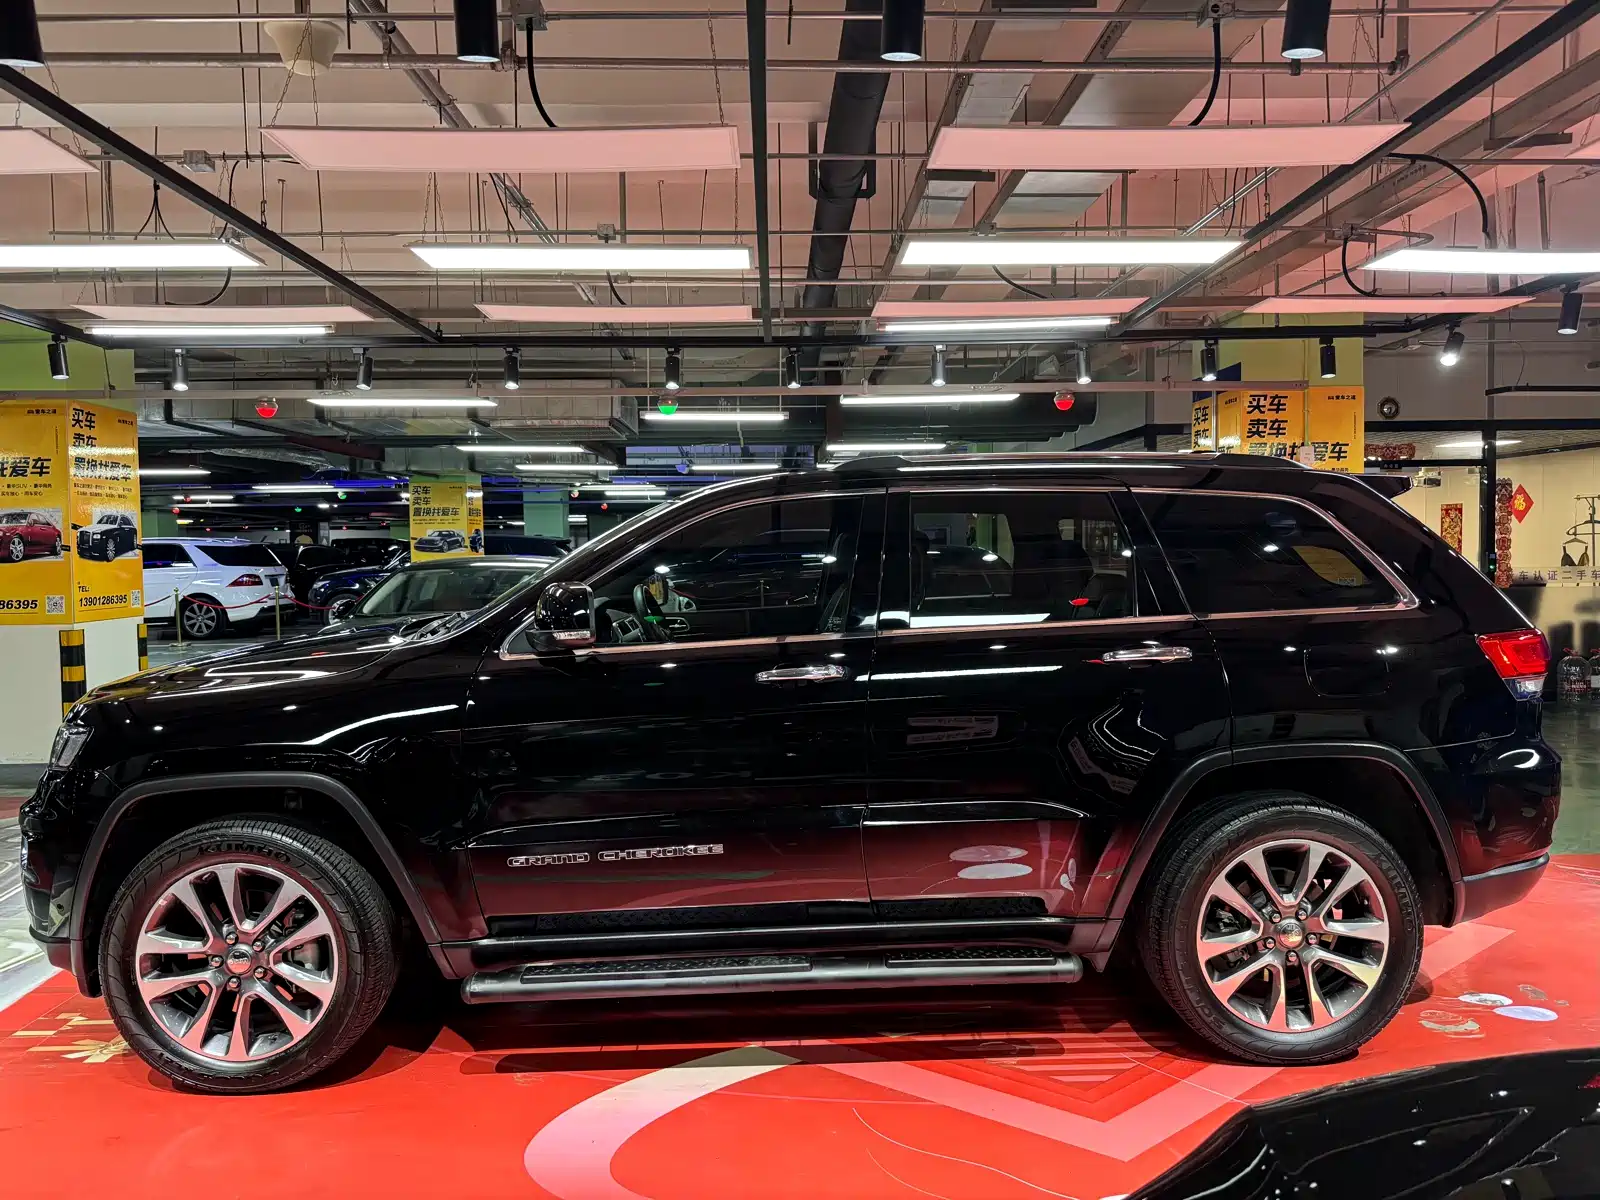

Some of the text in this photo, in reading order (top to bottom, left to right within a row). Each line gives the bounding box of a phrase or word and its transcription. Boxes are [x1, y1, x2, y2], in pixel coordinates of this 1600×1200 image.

[1247, 394, 1288, 414] 买车
[72, 408, 96, 430] 买车
[1193, 405, 1210, 427] 买车
[1247, 418, 1288, 438] 卖车
[412, 486, 431, 496] 买车
[412, 496, 431, 506] 卖车
[79, 594, 128, 607] 13901286395
[507, 844, 724, 867] GRAND CHEROKEE
